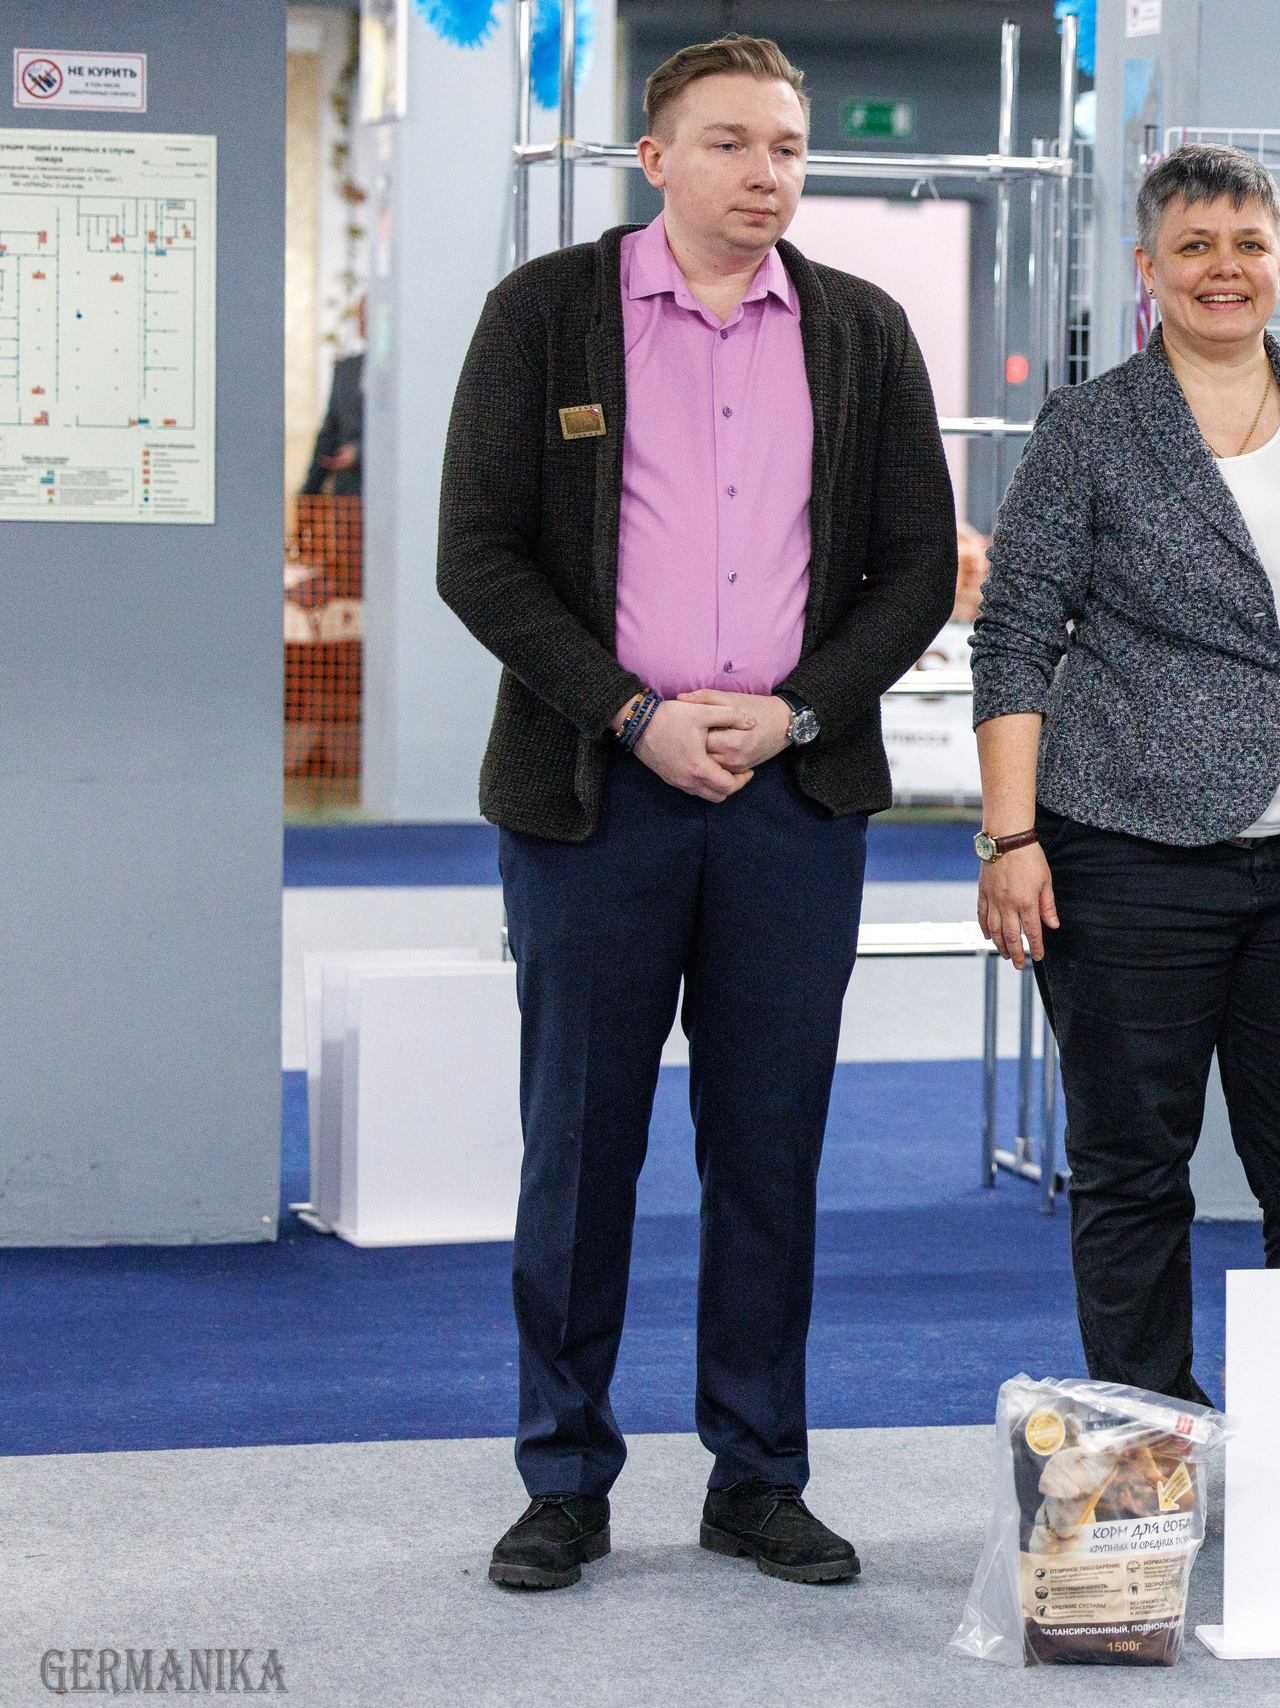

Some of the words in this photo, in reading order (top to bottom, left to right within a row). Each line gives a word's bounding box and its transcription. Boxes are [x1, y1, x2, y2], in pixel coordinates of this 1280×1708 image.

[67, 66, 84, 77] НЕ
[88, 66, 137, 79] КУРИТЬ
[1092, 1525, 1128, 1540] КОРМ
[1130, 1522, 1160, 1541] ДЛЯ
[1089, 1542, 1128, 1554] КРУПНЫХ
[1131, 1542, 1137, 1550] И
[1139, 1539, 1174, 1551] СРЕДНИХ
[1107, 1640, 1142, 1653] 1500г
